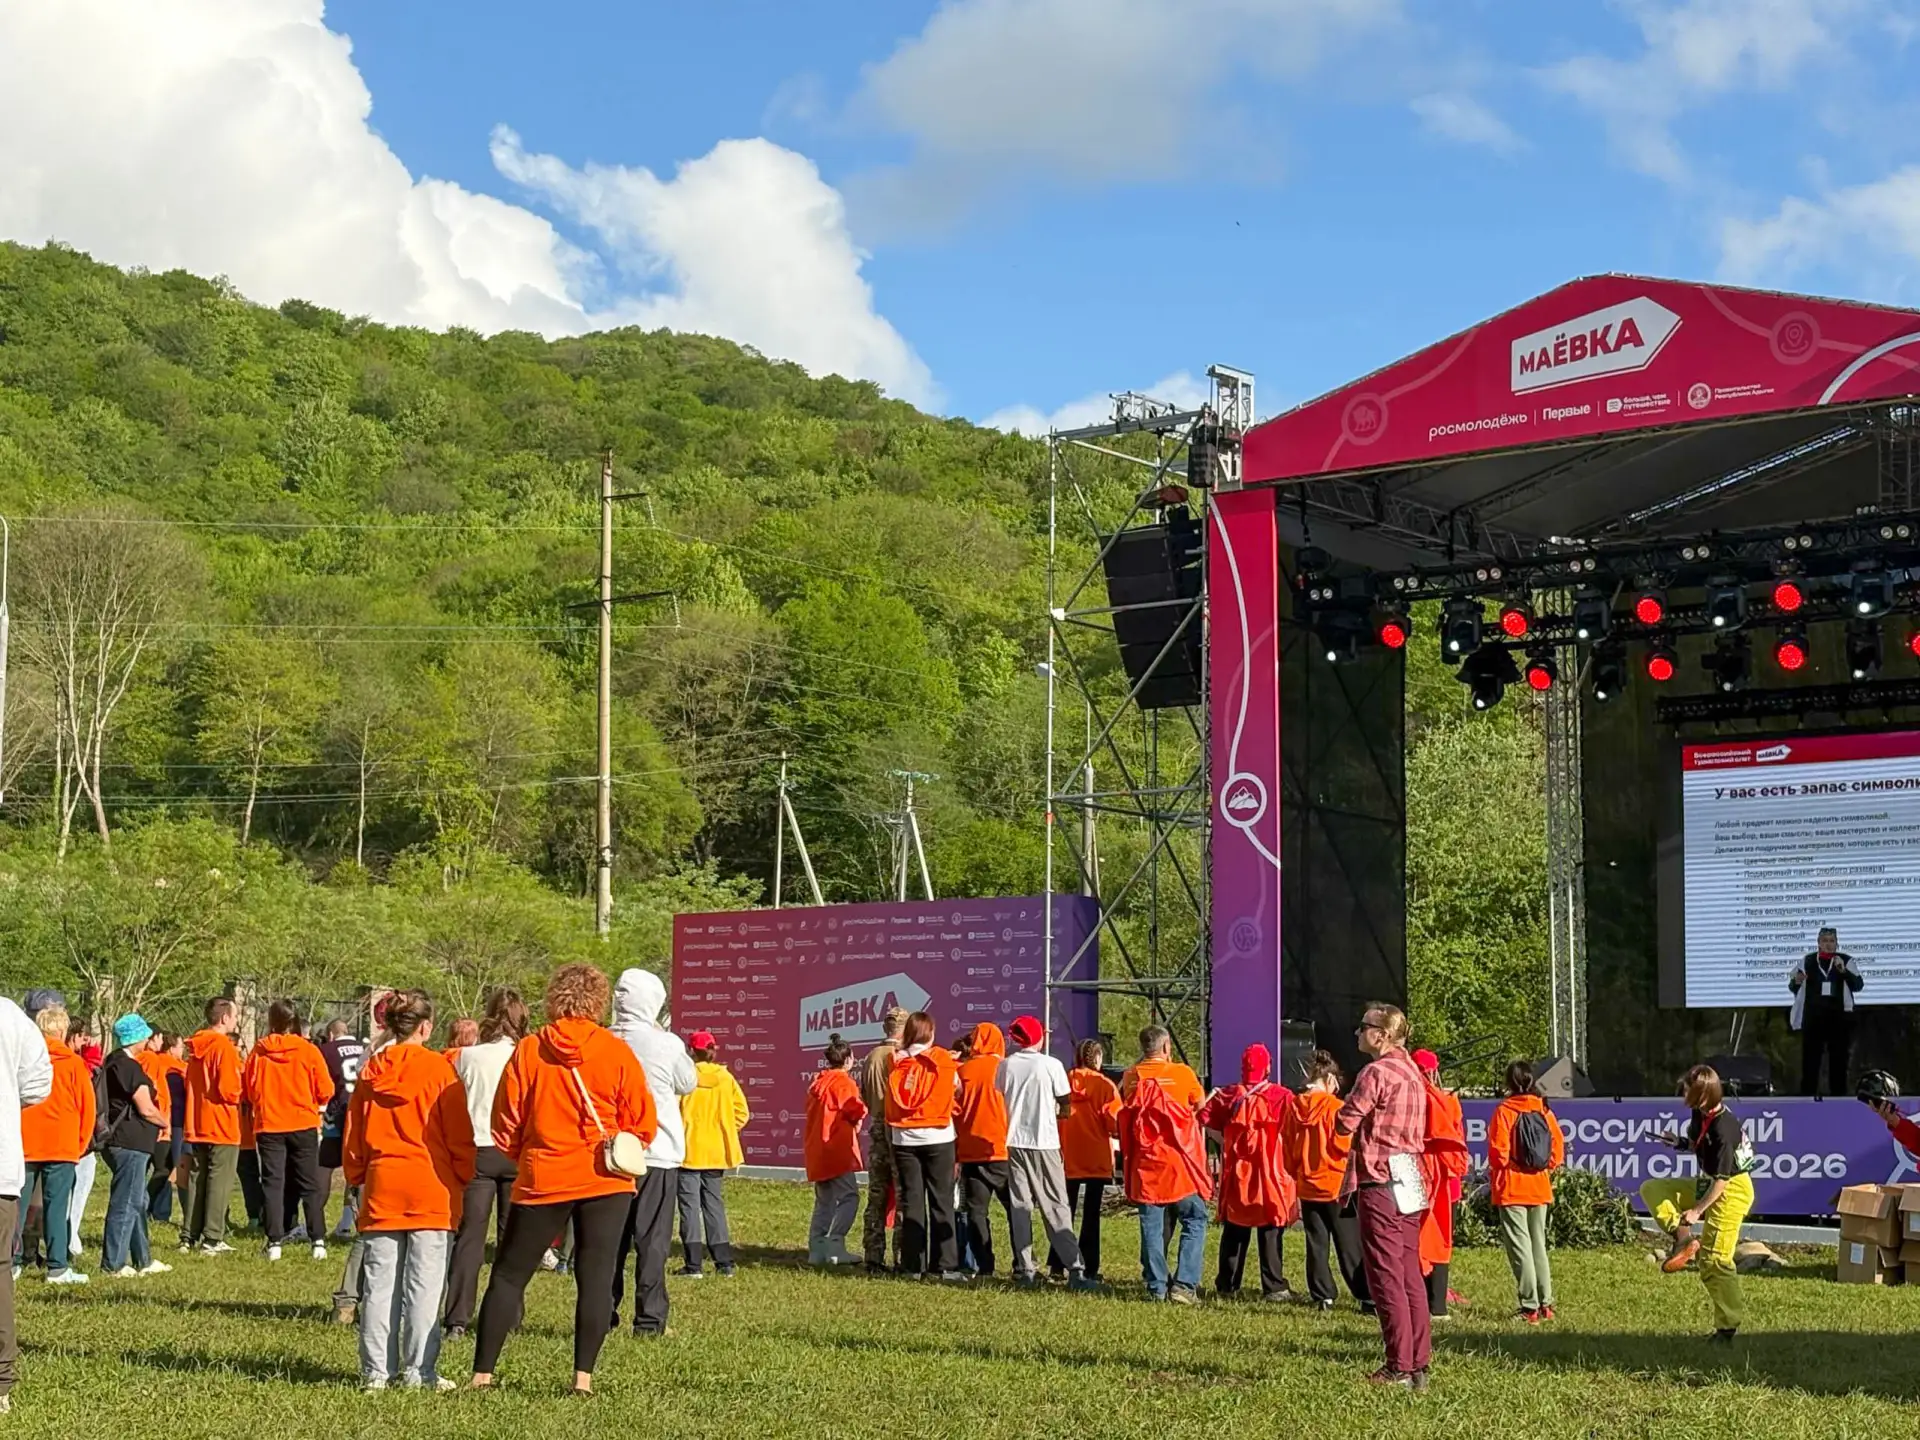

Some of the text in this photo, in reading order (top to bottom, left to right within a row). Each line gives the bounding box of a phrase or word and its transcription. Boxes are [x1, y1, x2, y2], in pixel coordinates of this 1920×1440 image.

[1519, 317, 1645, 376] МАЁВКА
[1542, 403, 1591, 421] Первые
[1429, 411, 1528, 441] росмолодёжь
[1715, 788, 1725, 800] У
[1730, 788, 1756, 799] вас
[1761, 785, 1796, 797] есть
[1801, 783, 1847, 795] запас
[1837, 826, 1880, 837] мастерство
[805, 991, 899, 1033] МАЁВКА
[1752, 1153, 1847, 1179] 2026
